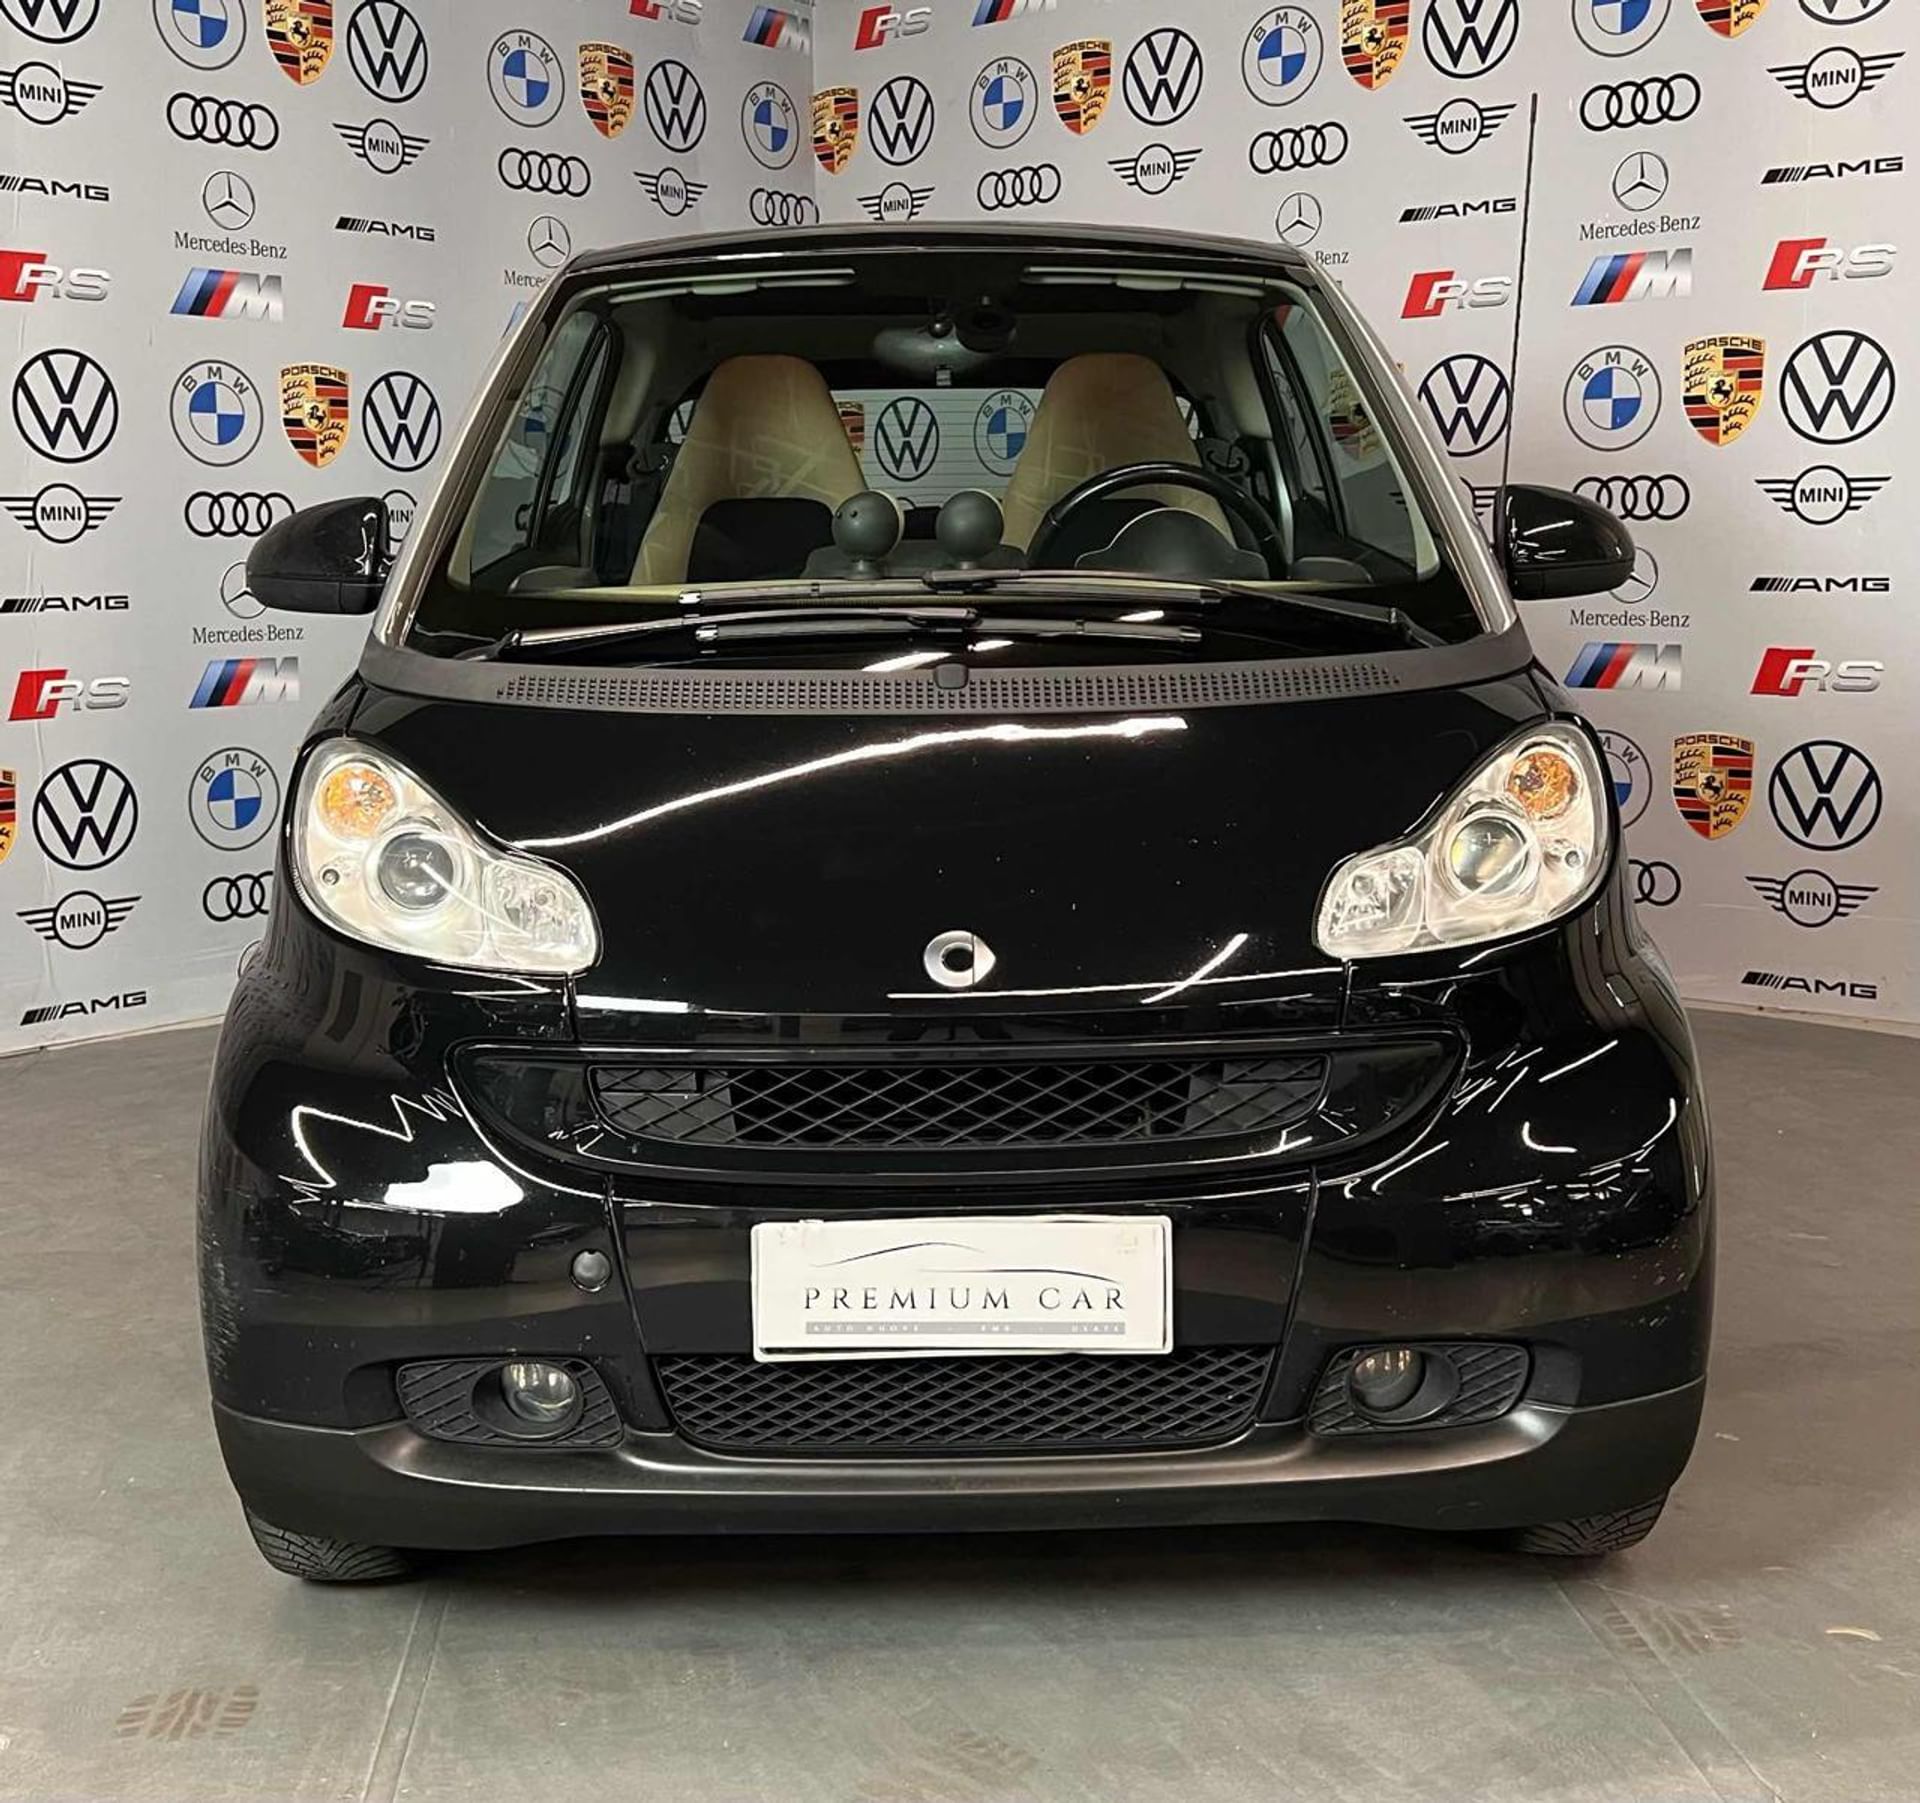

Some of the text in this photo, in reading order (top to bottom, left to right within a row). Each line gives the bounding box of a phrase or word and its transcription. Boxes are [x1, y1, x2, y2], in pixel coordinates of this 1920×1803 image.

[1811, 69, 1856, 88] MINI
[19, 85, 62, 103] MINI
[1440, 117, 1477, 135] MINI
[367, 137, 400, 156] MINI
[1140, 161, 1171, 177] MINI
[1803, 157, 1903, 181] AMG
[19, 179, 109, 201] AMG
[661, 184, 684, 201] MINI
[884, 198, 909, 213] MINI
[1434, 198, 1516, 219] AMG
[365, 221, 435, 241] AMG
[1579, 215, 1700, 241] Mercedes-Benz
[174, 231, 287, 259] Mercedes-Benz
[1684, 337, 1764, 353] PORSCHE
[281, 365, 346, 382] PORSCHE
[1799, 487, 1844, 504] MINI
[40, 505, 82, 522] MINI
[1791, 577, 1890, 592] AMG
[39, 595, 129, 611] AMG
[1570, 609, 1690, 628] Mercedes-Benz
[192, 625, 304, 644] Mercedes-Benz
[1674, 734, 1752, 750] PORSCHE
[1789, 889, 1832, 908] MINI
[60, 910, 102, 930] MINI
[1781, 977, 1877, 999] AMG
[60, 990, 147, 1019] AMG
[804, 1286, 1126, 1310] PREMIUM CAR
